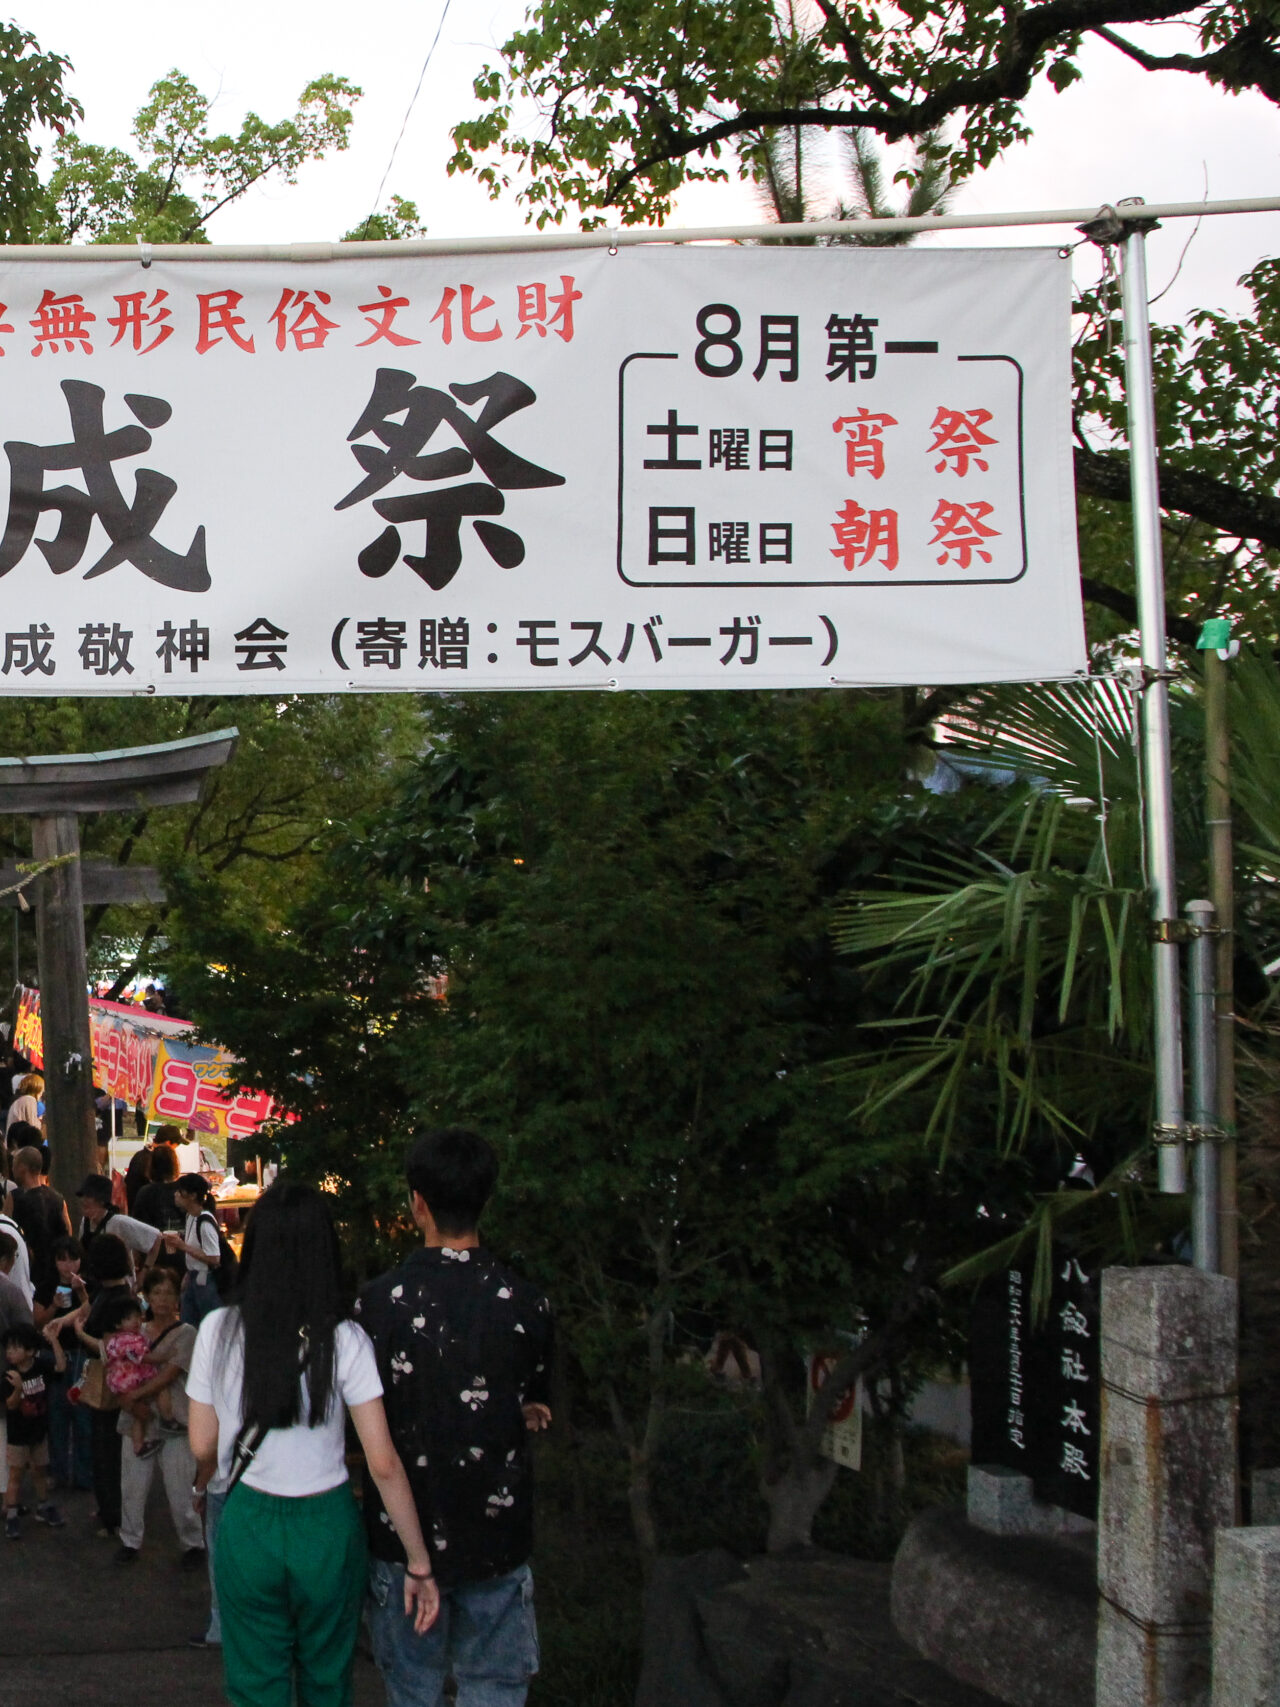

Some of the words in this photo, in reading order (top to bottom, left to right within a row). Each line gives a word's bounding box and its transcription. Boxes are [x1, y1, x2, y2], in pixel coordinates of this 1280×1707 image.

[643, 409, 794, 471] 土曜日
[831, 406, 999, 481] 宵祭
[647, 506, 794, 567] 日曜日
[830, 498, 1002, 572] 朝祭
